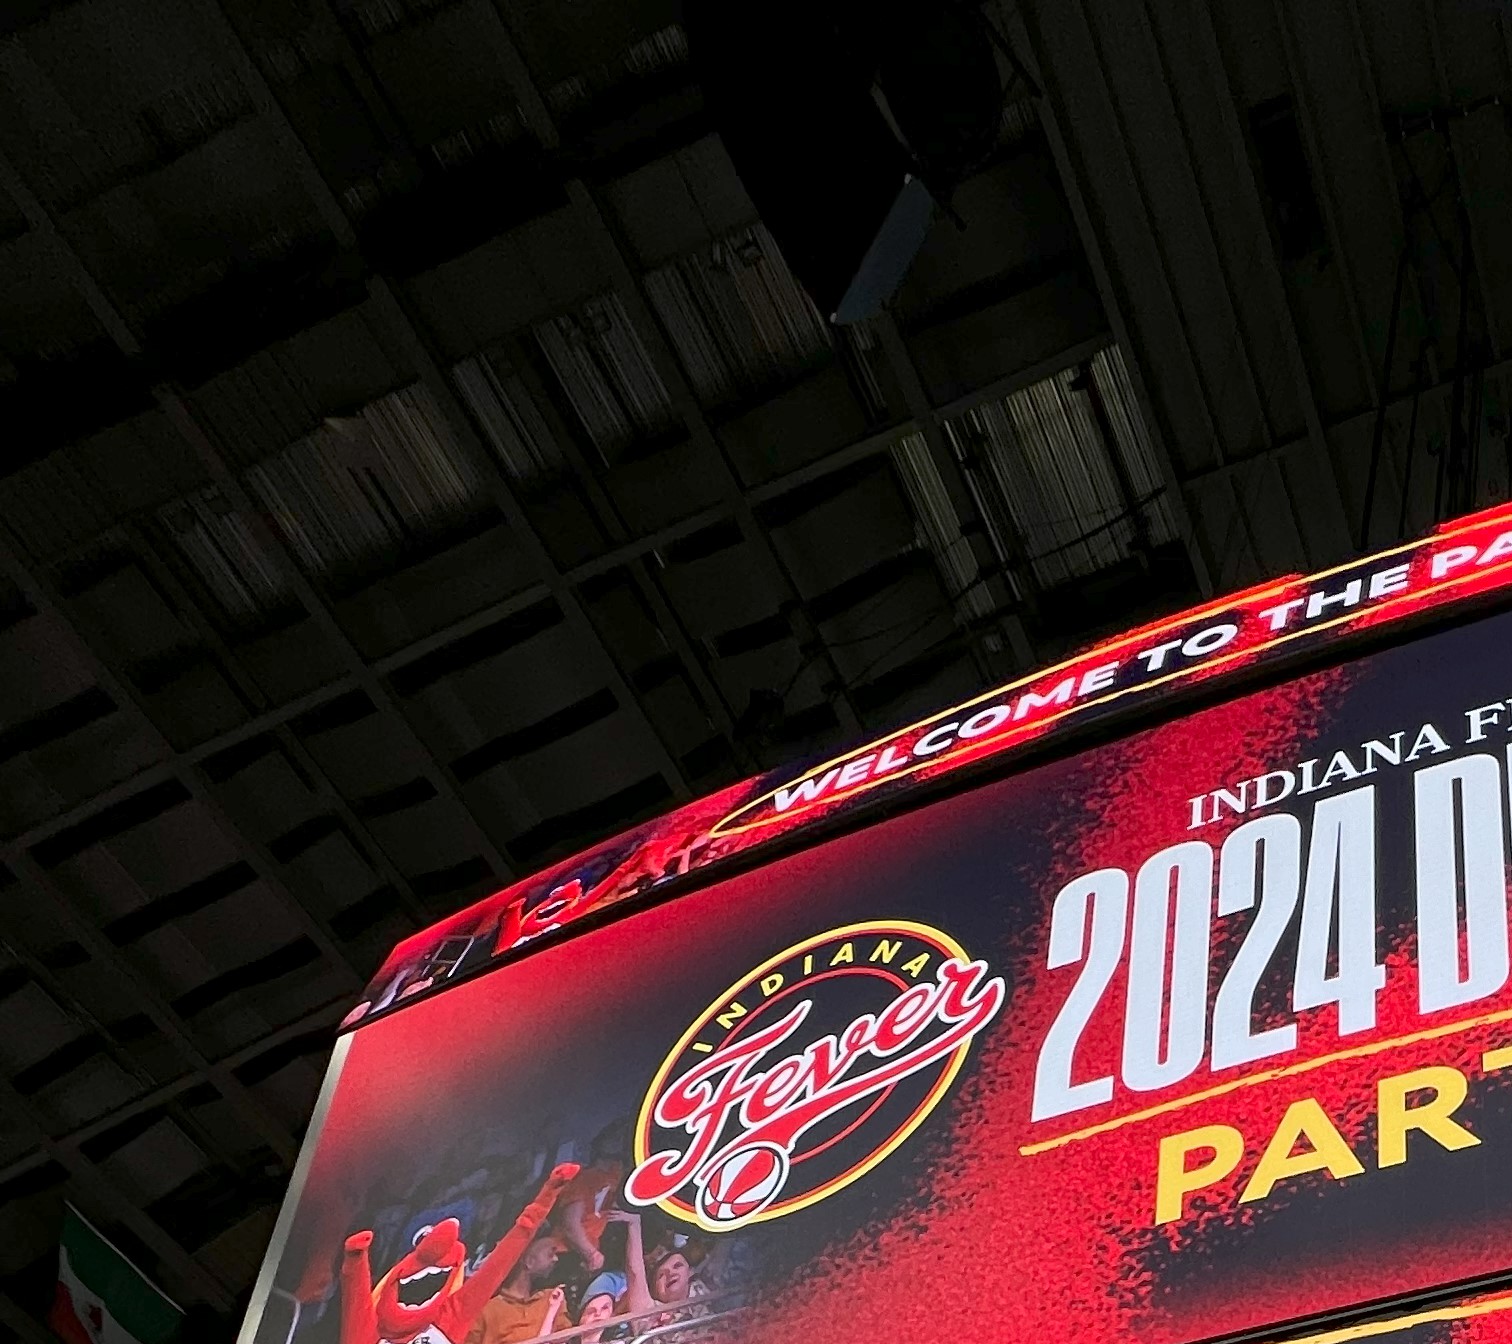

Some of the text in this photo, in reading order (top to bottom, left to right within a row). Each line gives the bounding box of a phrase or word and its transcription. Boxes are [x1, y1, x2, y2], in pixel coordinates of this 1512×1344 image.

[773, 662, 1117, 814] WELCOME
[1138, 622, 1239, 674] TO
[1258, 562, 1411, 632] THE
[1186, 722, 1451, 831] INDIANA
[692, 938, 931, 1054] INDIANA
[1033, 783, 1387, 1123] 2024
[623, 956, 1006, 1210] Fever
